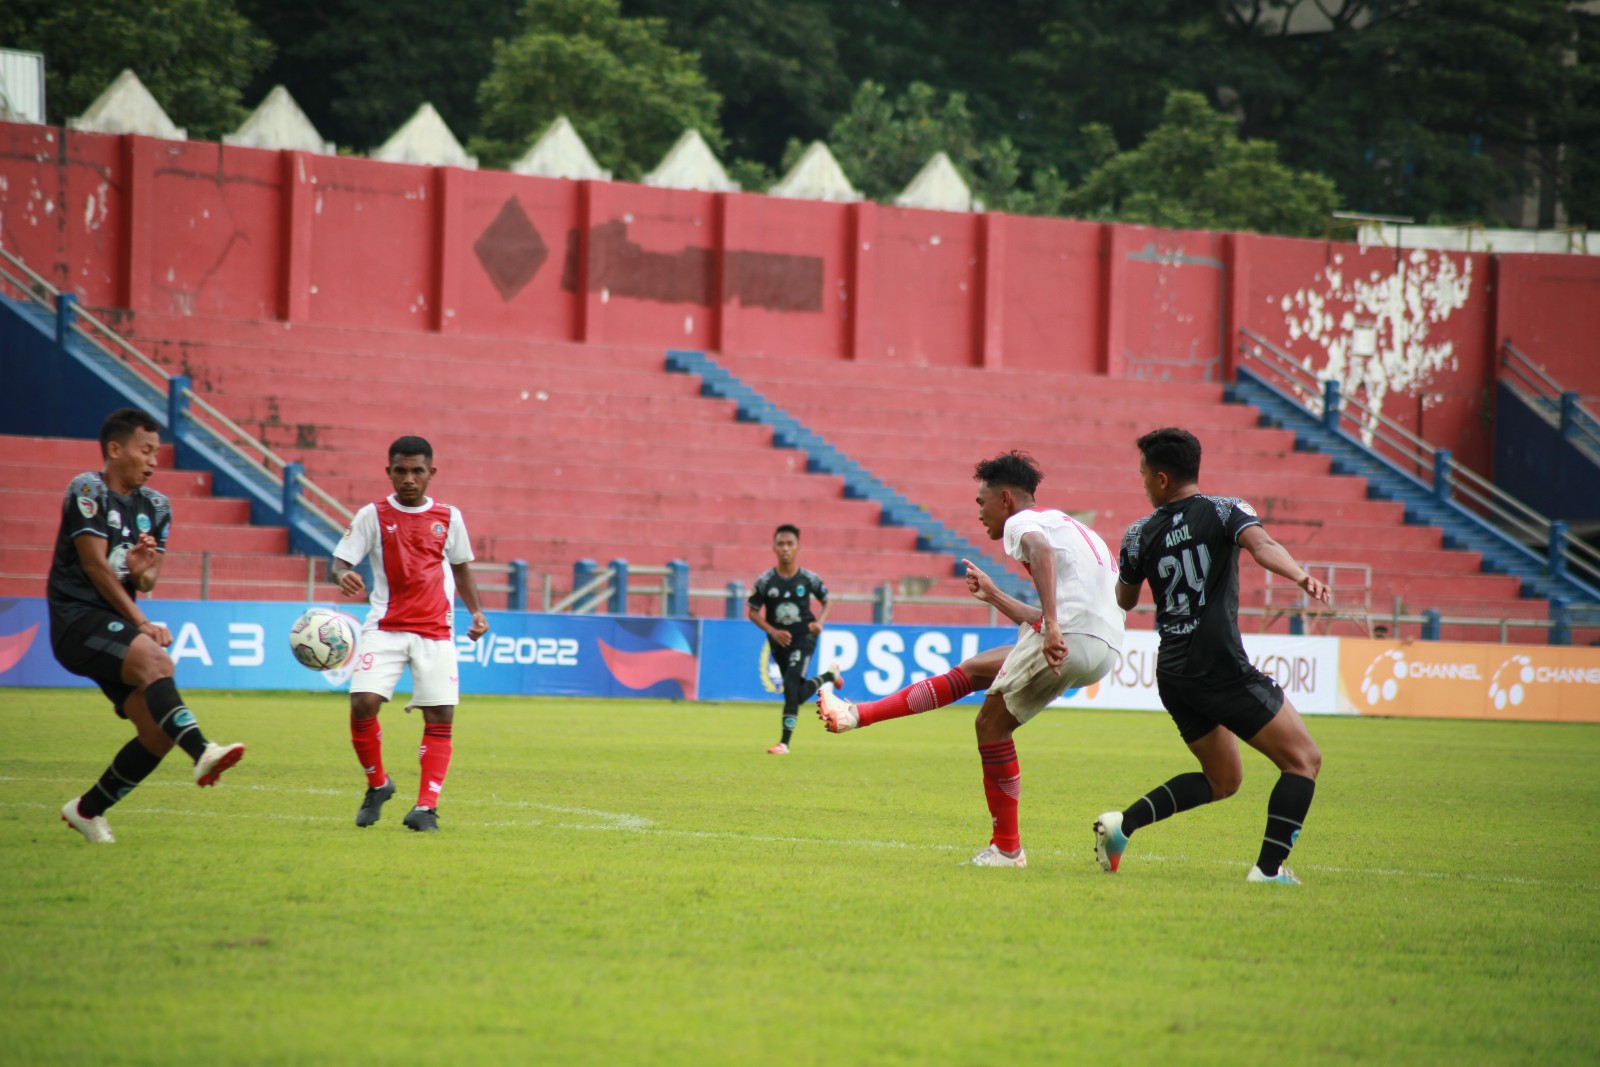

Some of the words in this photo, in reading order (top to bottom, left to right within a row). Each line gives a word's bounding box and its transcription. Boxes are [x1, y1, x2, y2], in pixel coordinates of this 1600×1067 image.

[1165, 524, 1193, 548] AIRUL
[1157, 543, 1212, 616] 24
[153, 621, 213, 666] A
[228, 623, 265, 667] 3
[816, 629, 979, 697] PSSI
[1110, 649, 1159, 688] RSU
[1254, 655, 1316, 693] EDIRI
[1408, 661, 1483, 681] CHANNEL
